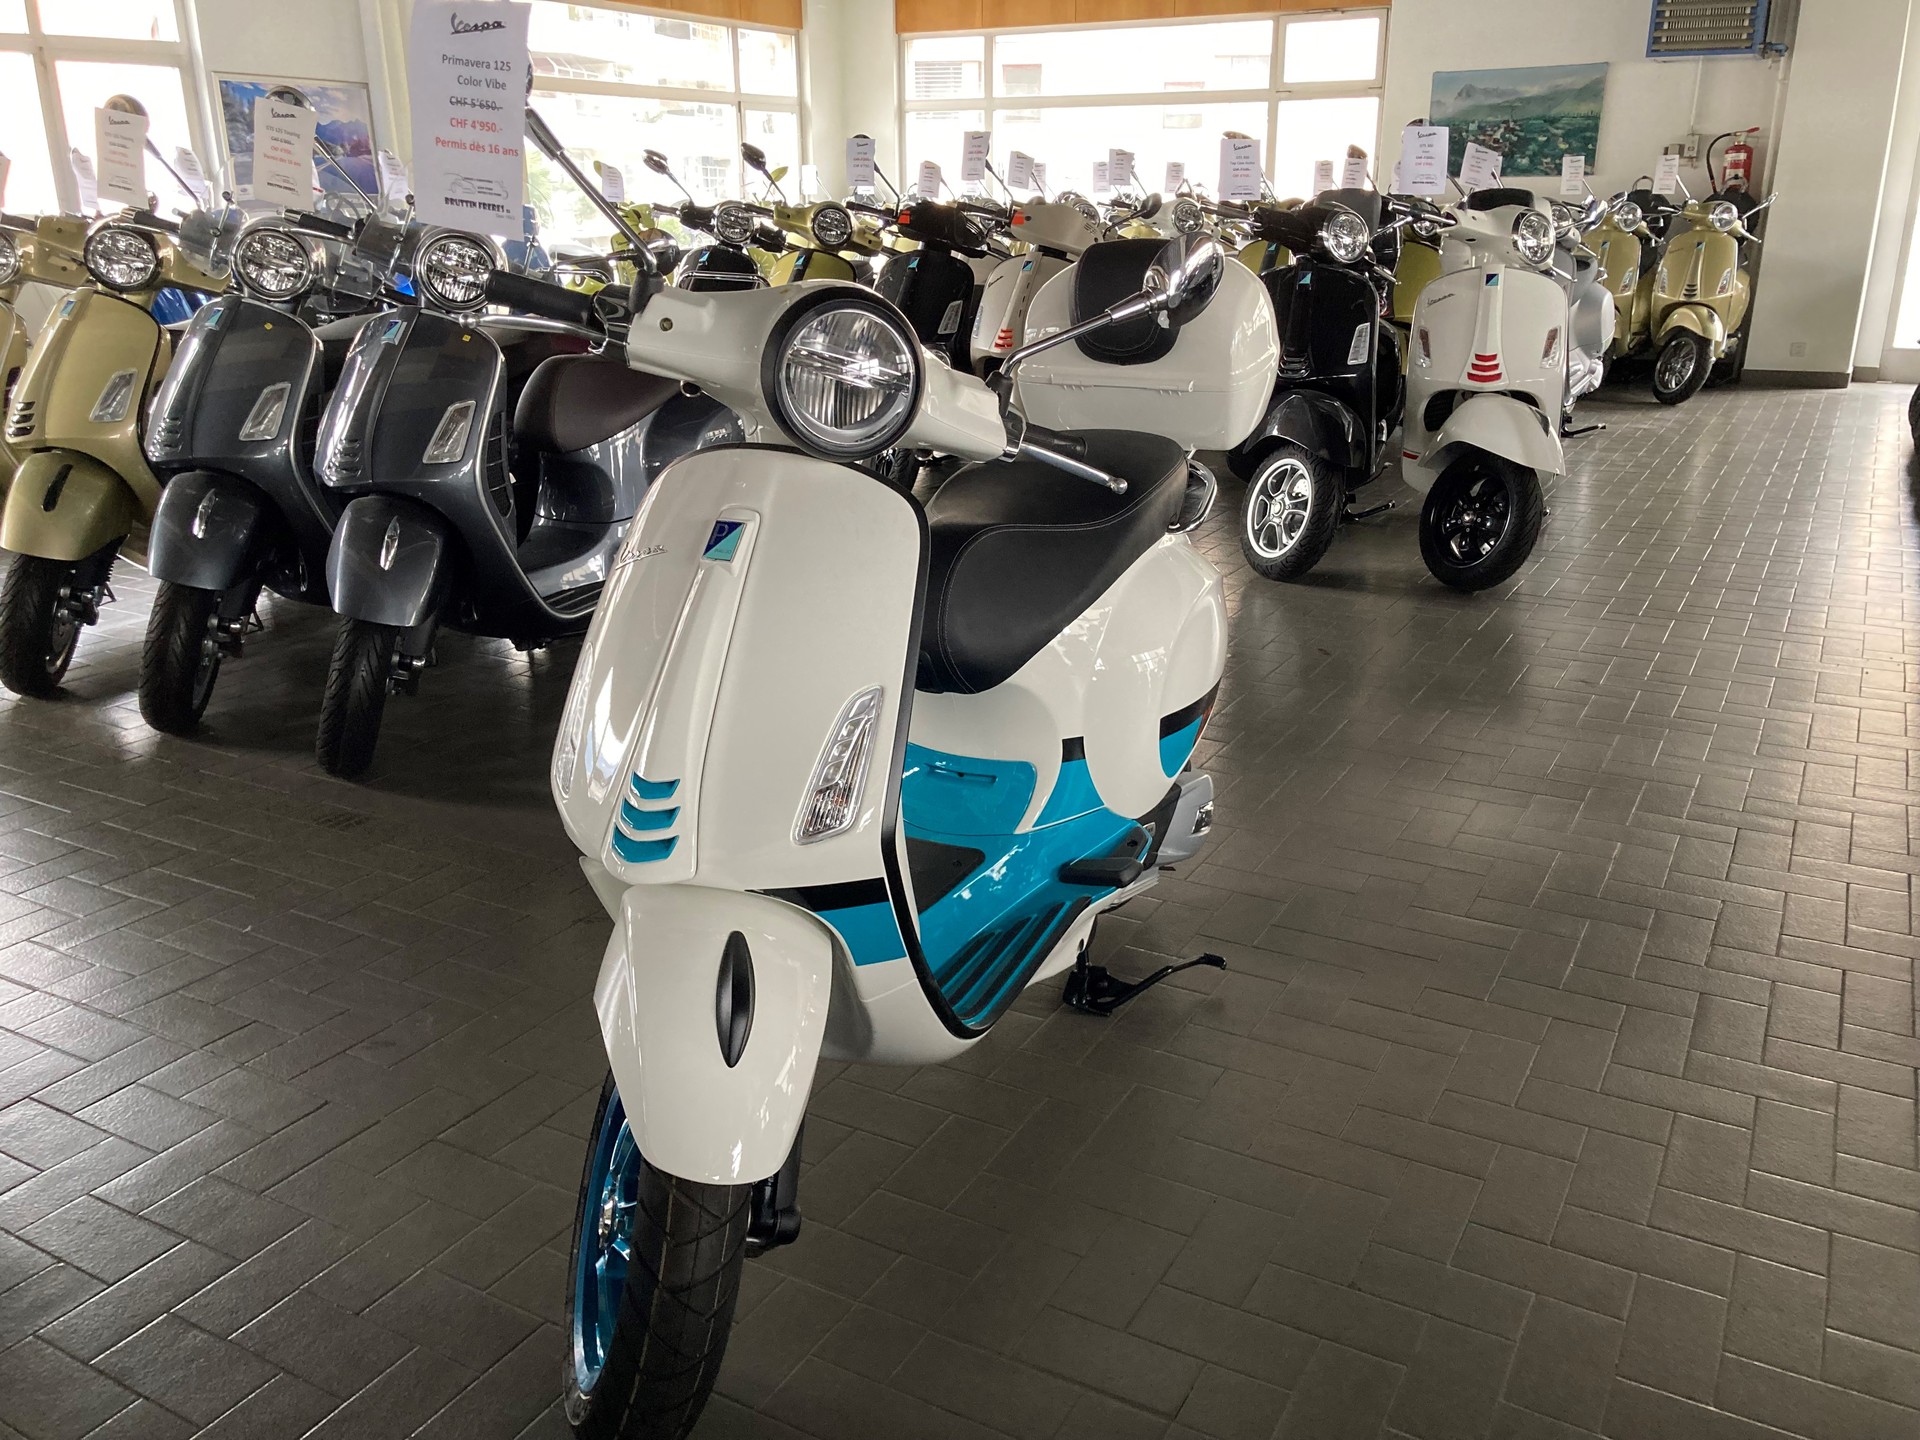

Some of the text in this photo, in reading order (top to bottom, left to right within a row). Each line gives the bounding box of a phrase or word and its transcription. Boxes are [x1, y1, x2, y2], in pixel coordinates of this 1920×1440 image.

[451, 12, 507, 35] Vespa
[442, 54, 512, 72] Primavera 125
[457, 75, 507, 91] Color Vibe
[449, 95, 468, 107] CHF
[450, 117, 503, 133] CHF 4'950.-
[435, 136, 519, 157] Permis dès 16 ans
